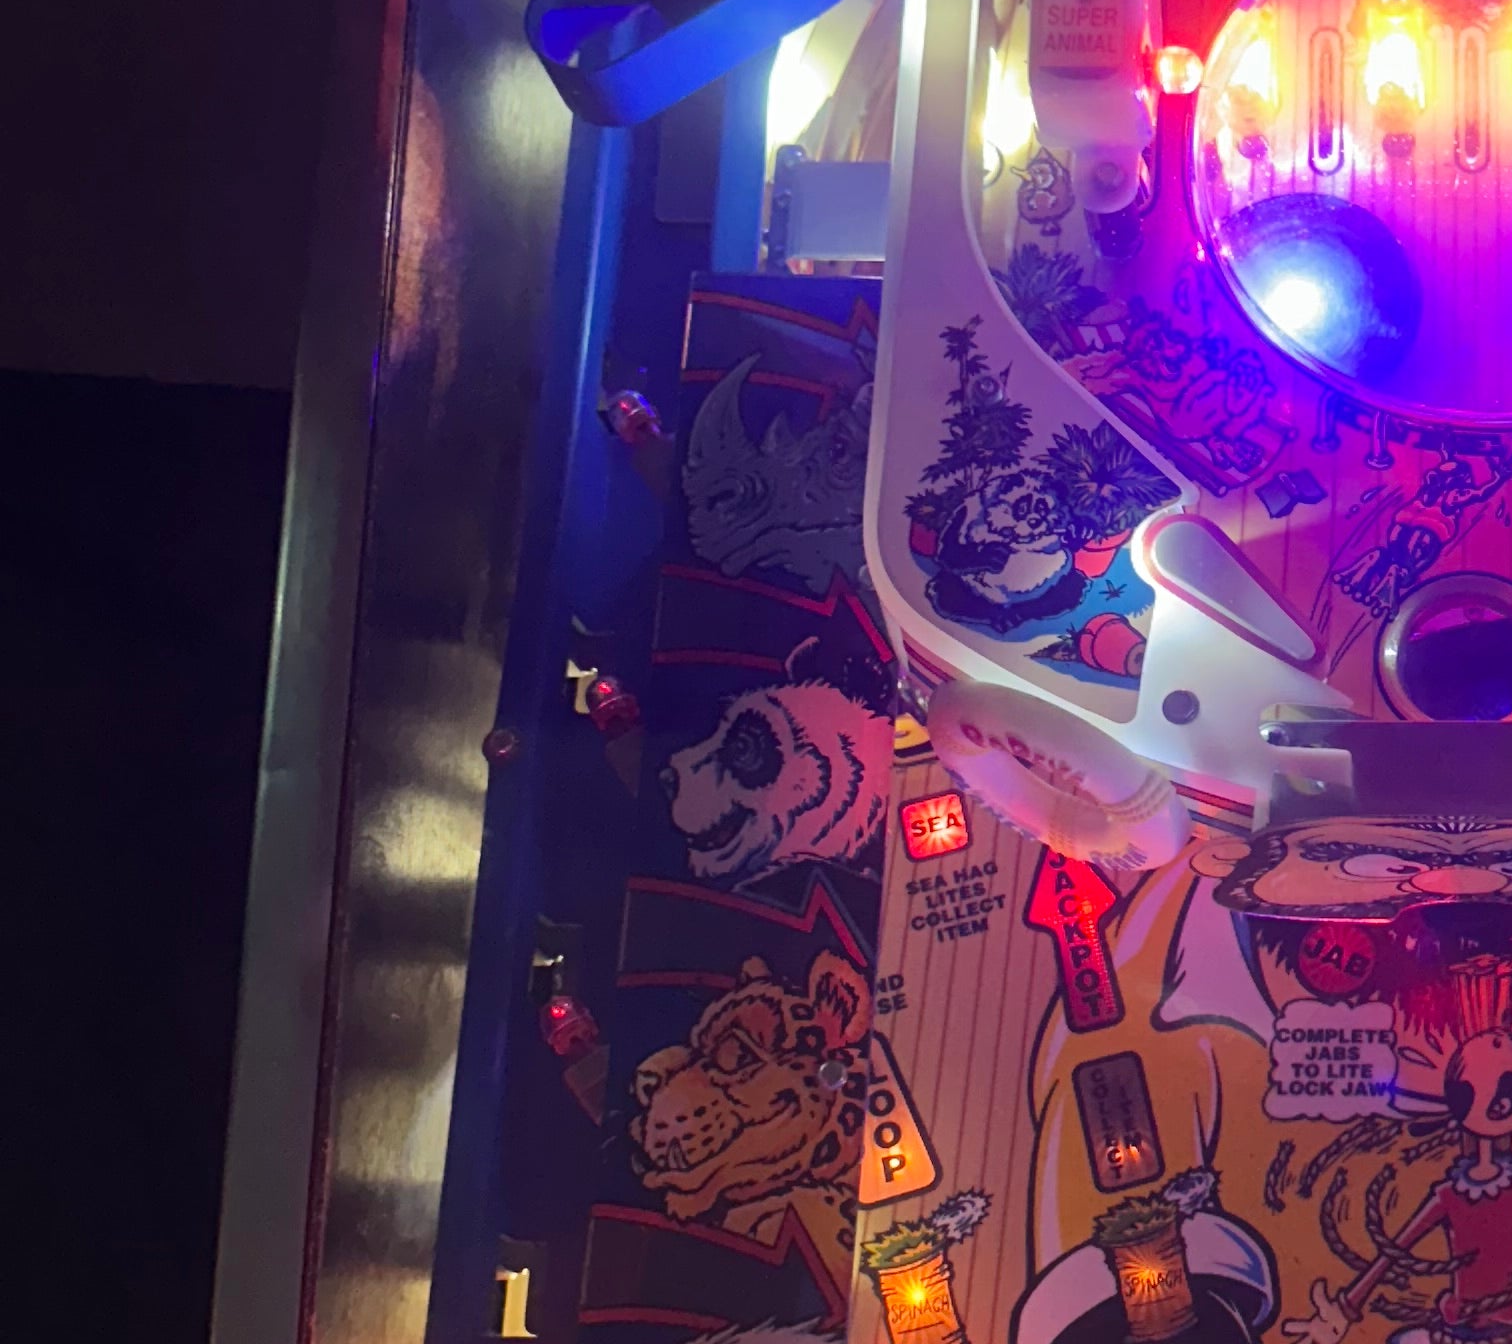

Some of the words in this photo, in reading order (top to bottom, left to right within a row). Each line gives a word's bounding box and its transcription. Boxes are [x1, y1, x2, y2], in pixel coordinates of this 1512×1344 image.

[1047, 5, 1118, 28] SUPER
[1044, 32, 1118, 54] ANIMAL
[911, 812, 963, 838] SEA
[906, 874, 948, 896] SEA
[953, 861, 999, 883] HAG
[925, 882, 987, 908] LITES
[911, 894, 1007, 931] COLLECT
[936, 917, 989, 944] ITEM
[1049, 852, 1101, 1017] JACKPOT
[1303, 938, 1371, 978] JAB
[1277, 1027, 1392, 1044] COMPLETE
[1305, 1045, 1361, 1062] JABS
[1291, 1063, 1322, 1079] TO
[1326, 1063, 1374, 1079] LITE
[1276, 1081, 1335, 1097] LOCK
[1341, 1080, 1389, 1097] JAW
[1123, 1267, 1183, 1297] SPINACH
[890, 1294, 951, 1324] SPINACH
